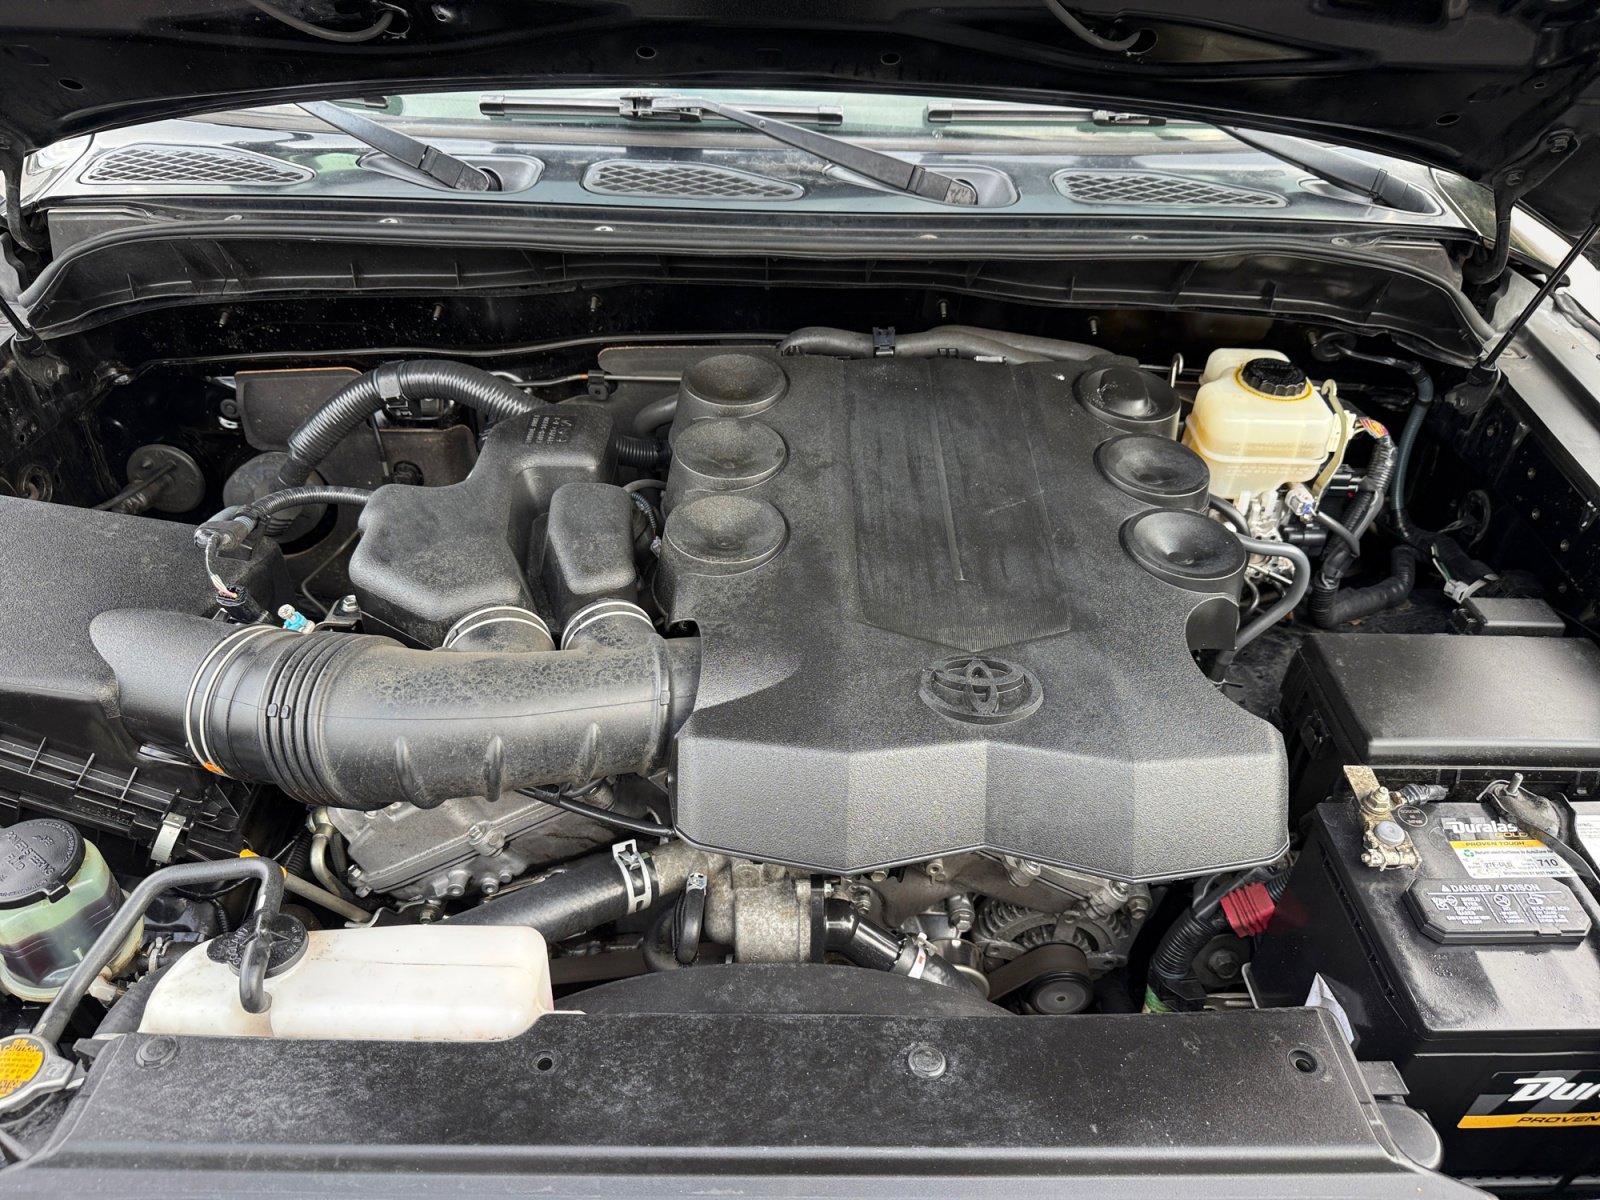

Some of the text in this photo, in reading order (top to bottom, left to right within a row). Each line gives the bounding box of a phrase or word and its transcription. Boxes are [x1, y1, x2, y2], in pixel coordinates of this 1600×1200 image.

[1536, 858, 1559, 867] 710
[1451, 884, 1493, 892] DANGER
[1501, 883, 1541, 892] POISON
[1508, 1076, 1600, 1102] Dur
[1517, 1115, 1600, 1123] PROVEN
